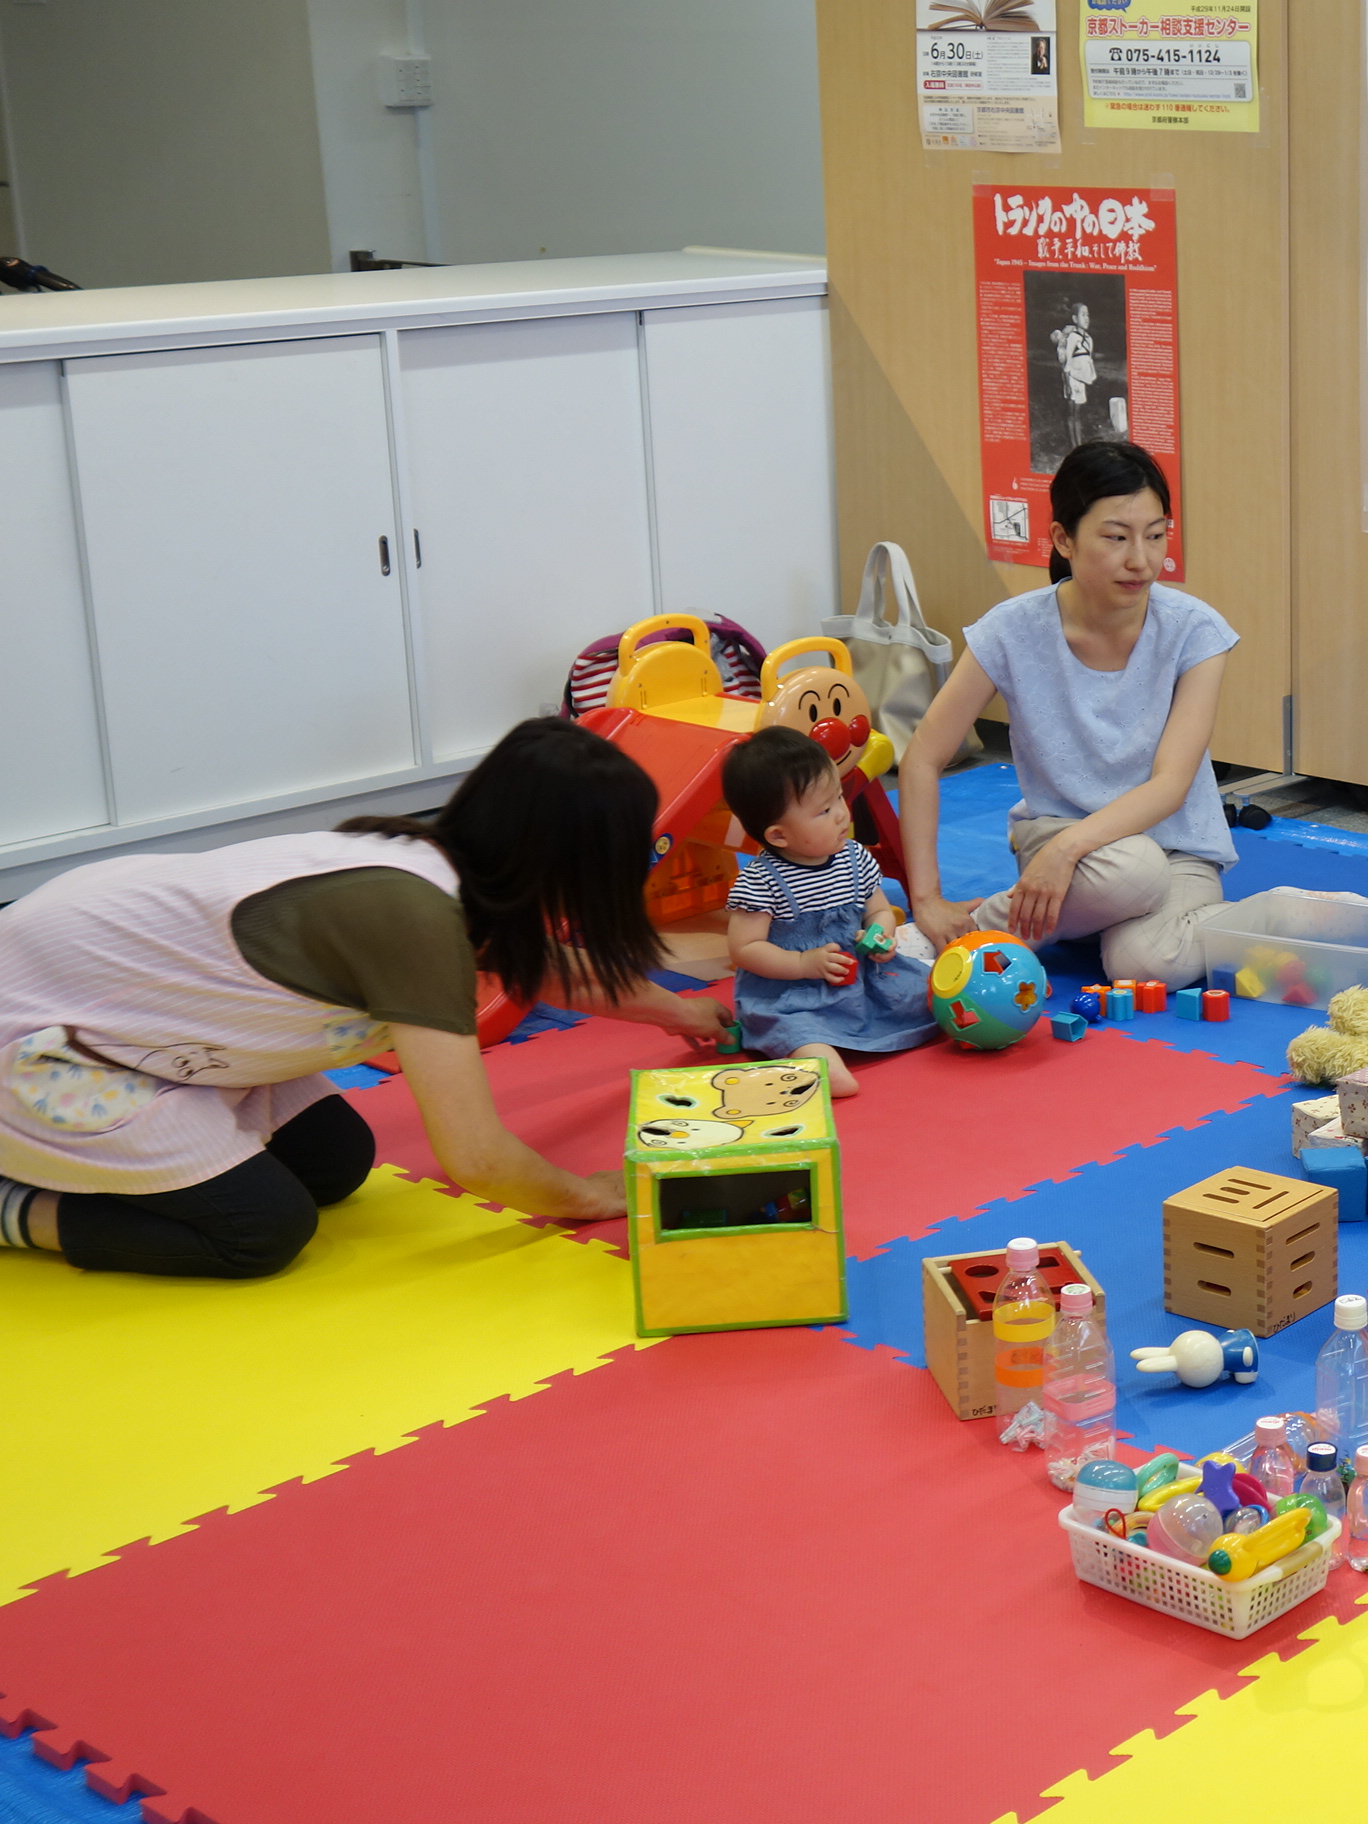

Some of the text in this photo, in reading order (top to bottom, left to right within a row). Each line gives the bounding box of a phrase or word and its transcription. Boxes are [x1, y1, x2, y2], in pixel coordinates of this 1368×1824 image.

[1087, 18, 1250, 36] 京都ストーカー相談支援センター
[931, 42, 983, 60] 6月30日(土)
[1126, 48, 1221, 63] 075-415-1124
[994, 192, 1155, 240] トラックの中の日本
[1273, 1312, 1296, 1334] ひだまり
